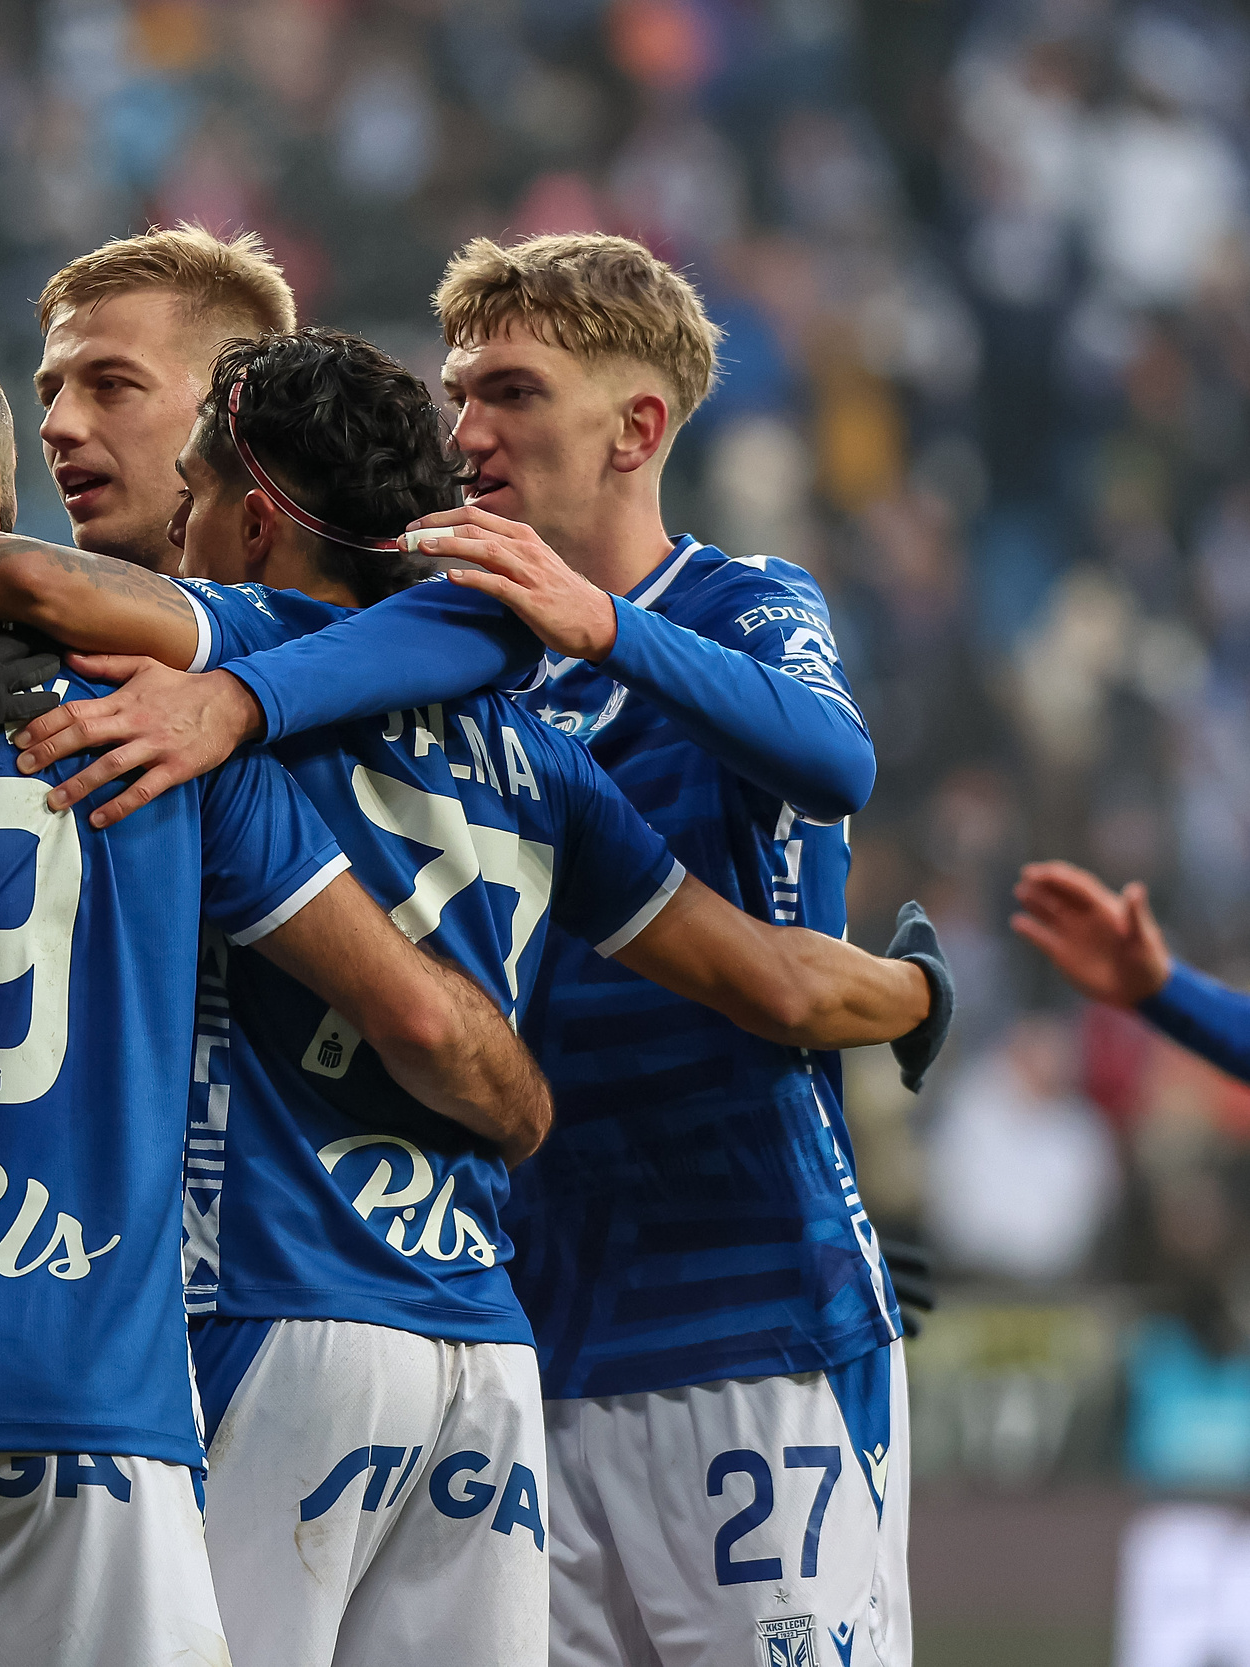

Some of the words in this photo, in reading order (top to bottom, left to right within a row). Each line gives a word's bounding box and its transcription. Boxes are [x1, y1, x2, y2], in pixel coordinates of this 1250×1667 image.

[316, 1133, 498, 1268] Pils
[706, 1445, 843, 1586] 27
[766, 1622, 784, 1632] KKS
[784, 1618, 807, 1630] LECH
